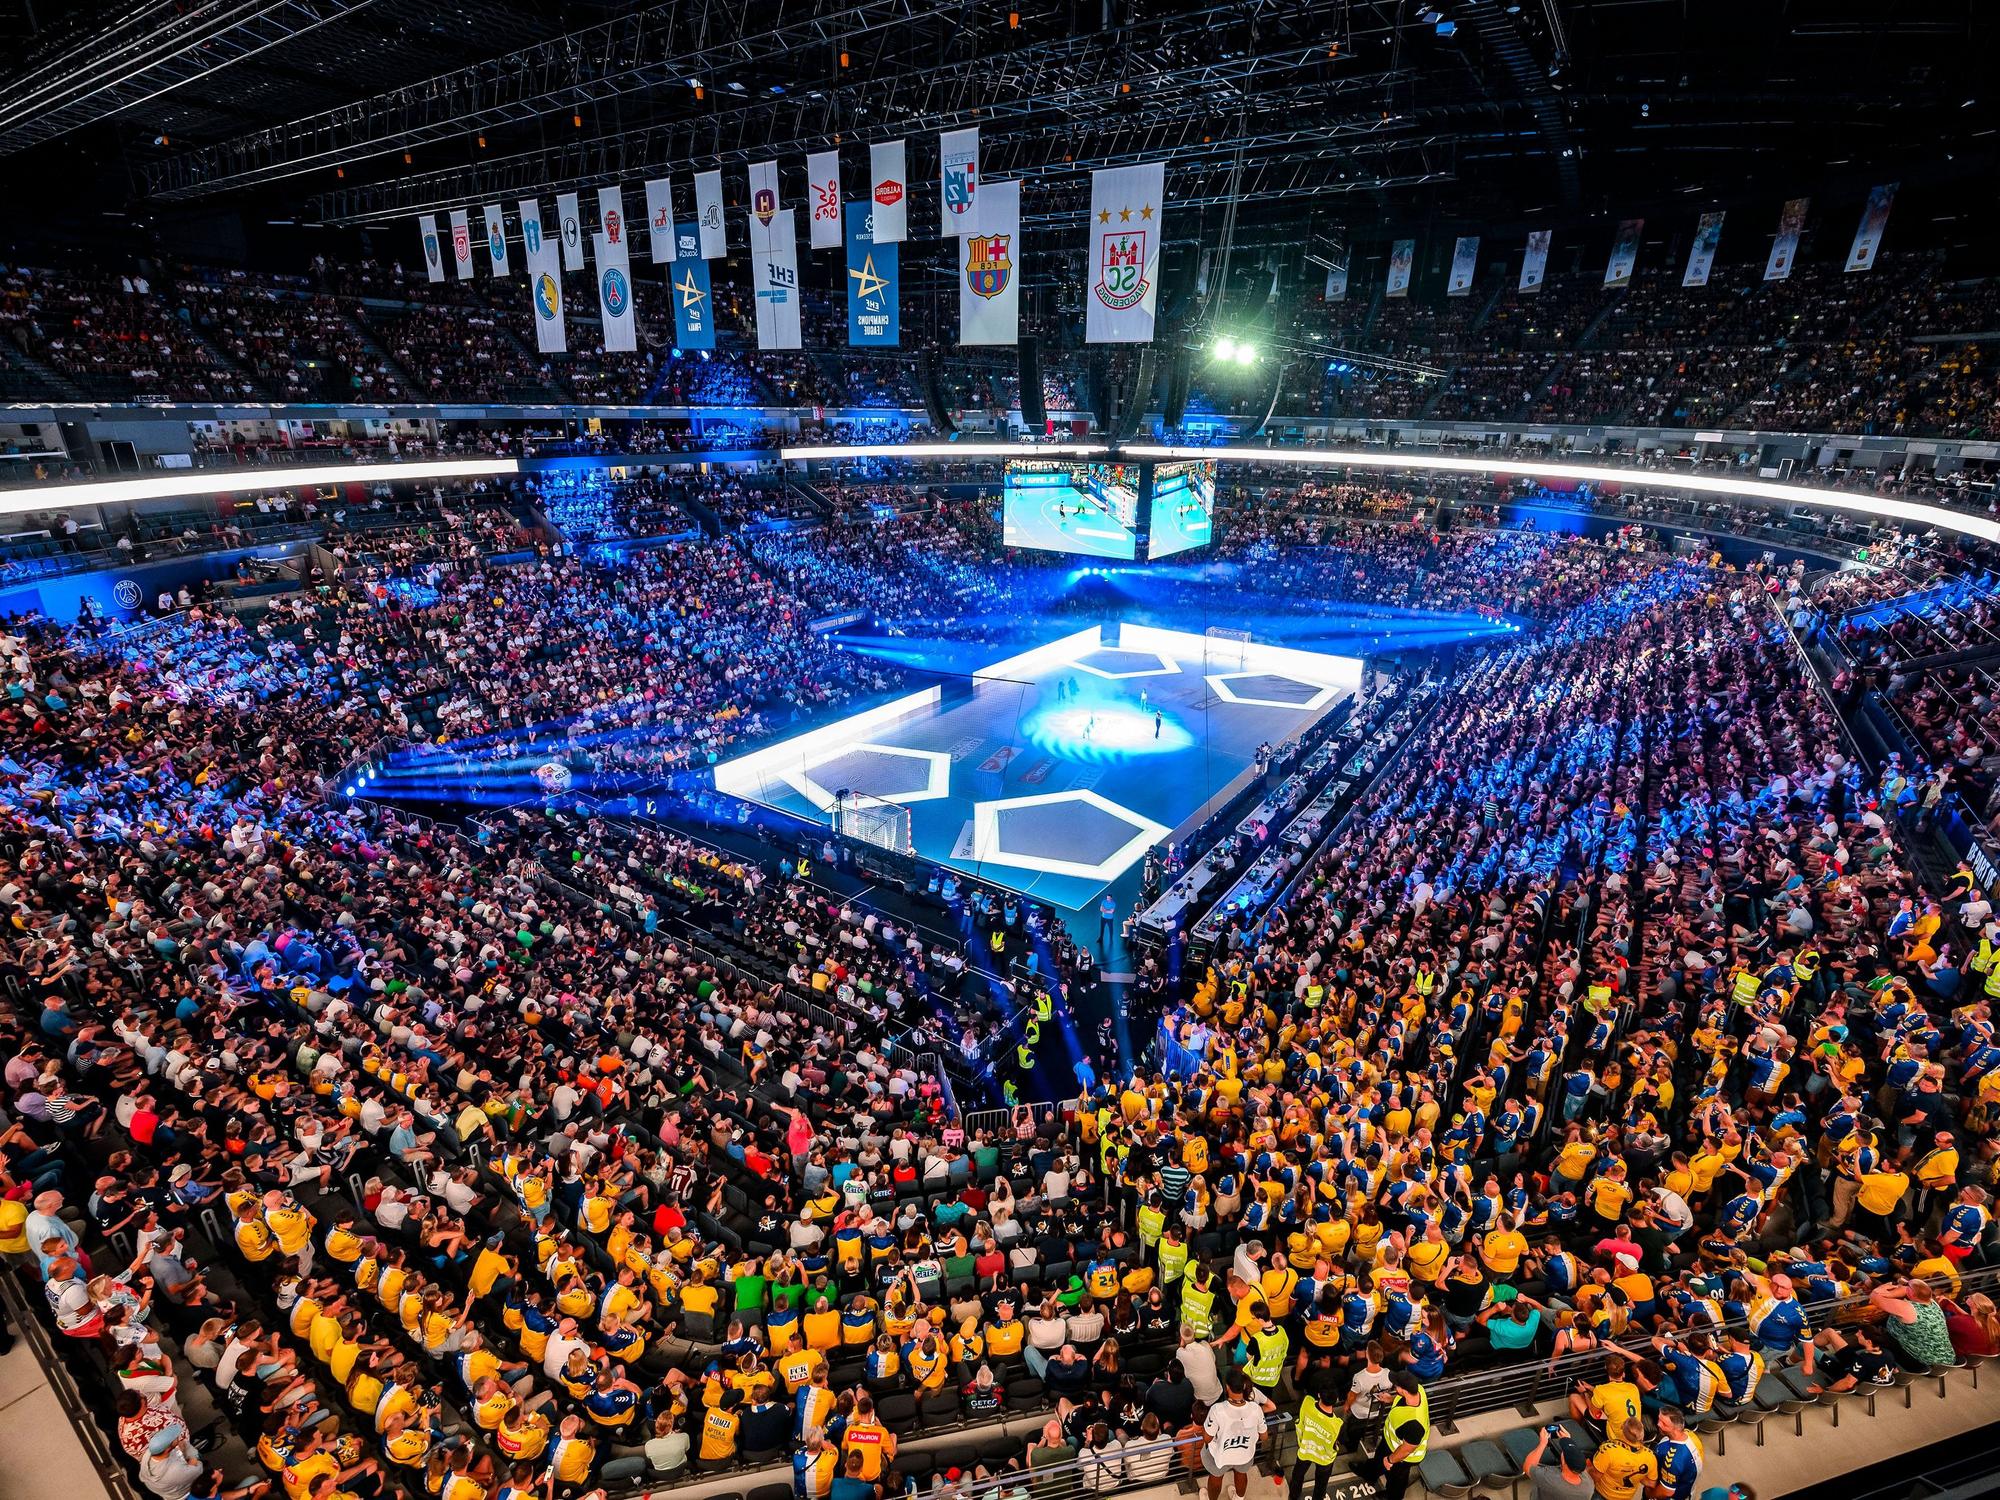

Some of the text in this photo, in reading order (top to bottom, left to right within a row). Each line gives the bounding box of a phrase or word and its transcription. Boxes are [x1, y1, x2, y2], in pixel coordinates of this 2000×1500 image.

[1972, 849, 1991, 883] PART
[671, 1173, 683, 1191] 11
[845, 1185, 864, 1194] GETEC
[873, 1188, 893, 1198] GETEC
[915, 1268, 938, 1279] GETEC
[1099, 1274, 1115, 1287] 24
[1322, 1325, 1331, 1336] 2
[1625, 1398, 1637, 1418] 6
[857, 1434, 879, 1442] TAURON
[1223, 1435, 1251, 1452] EHF
